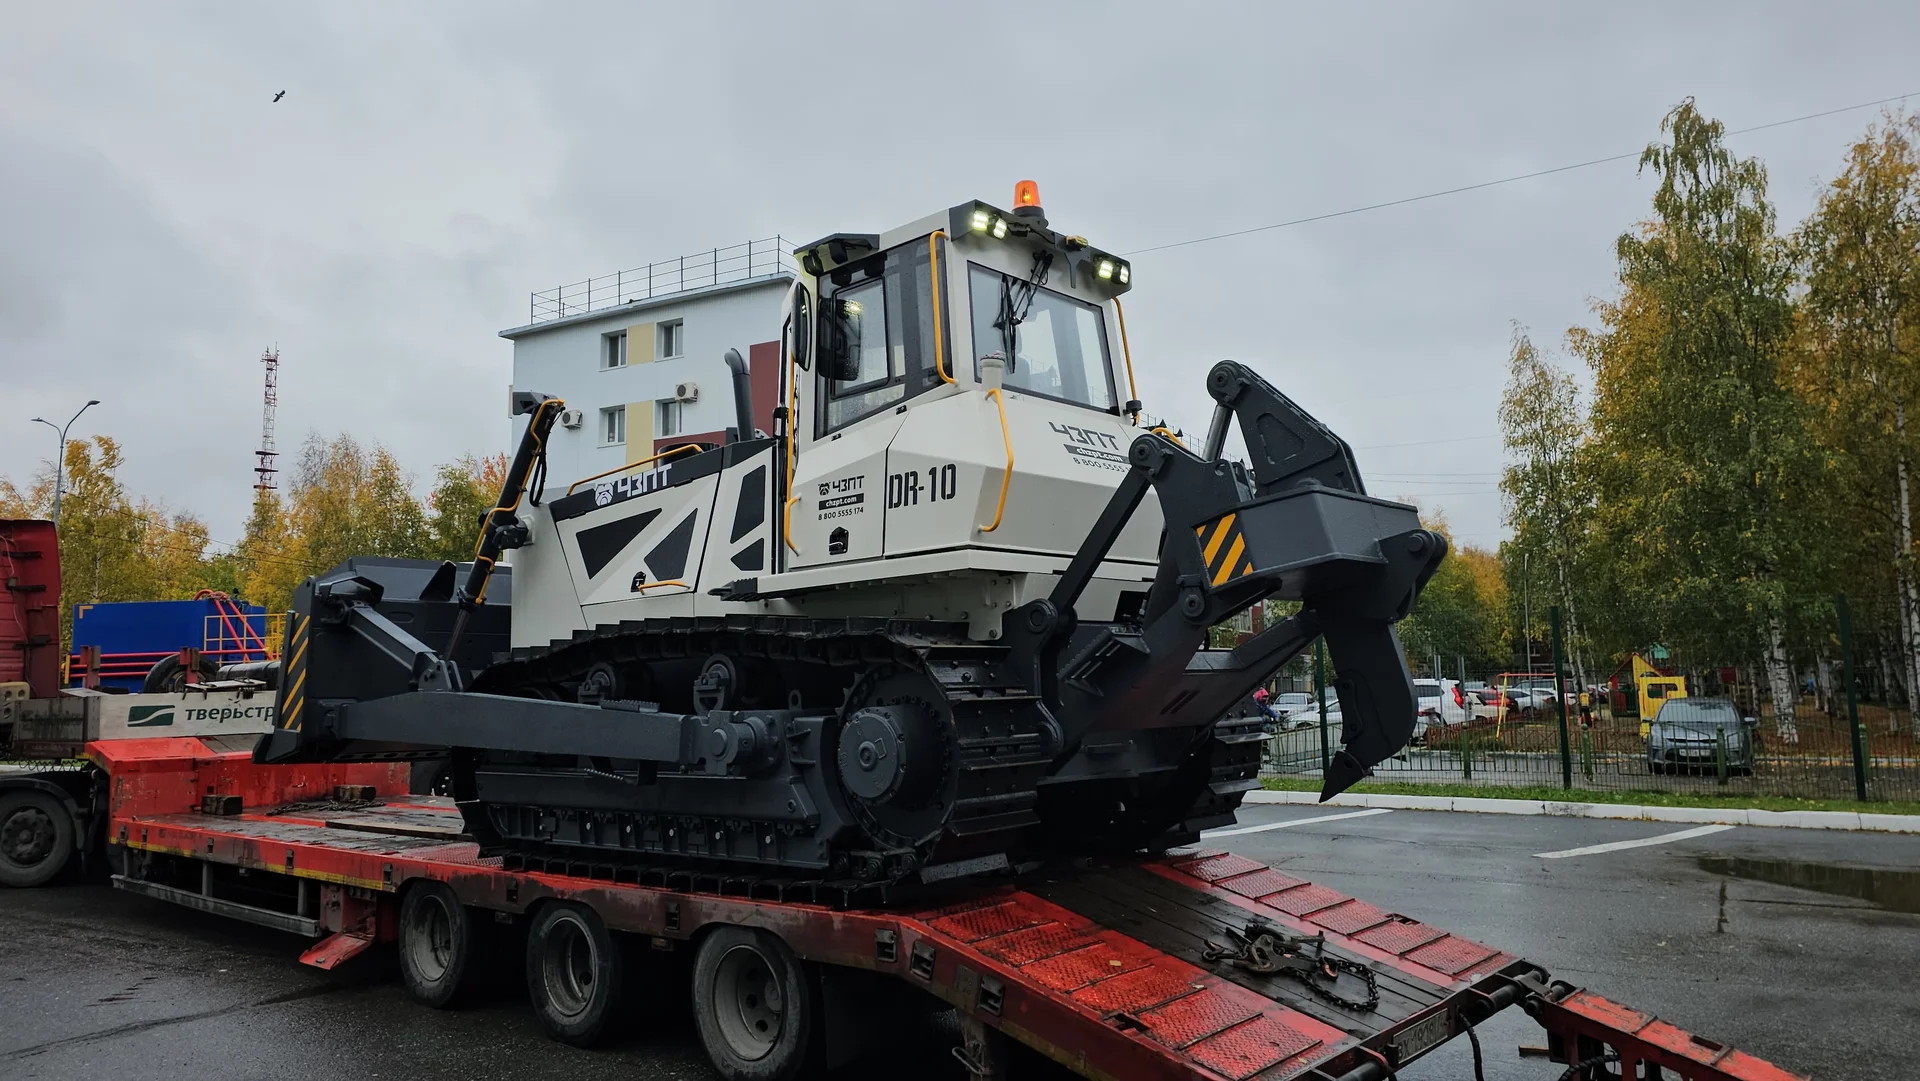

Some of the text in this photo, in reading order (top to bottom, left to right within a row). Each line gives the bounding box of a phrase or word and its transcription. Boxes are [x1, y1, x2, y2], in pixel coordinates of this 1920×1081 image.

[1048, 421, 1119, 451] ЧЗПТ
[617, 463, 672, 498] ЧЗПТ
[832, 475, 865, 492] ЧЗПТ
[888, 463, 957, 509] DR-10
[823, 511, 837, 520] 800
[837, 508, 853, 518] 5555
[853, 506, 864, 515] 174
[825, 496, 857, 507] chzpt.com
